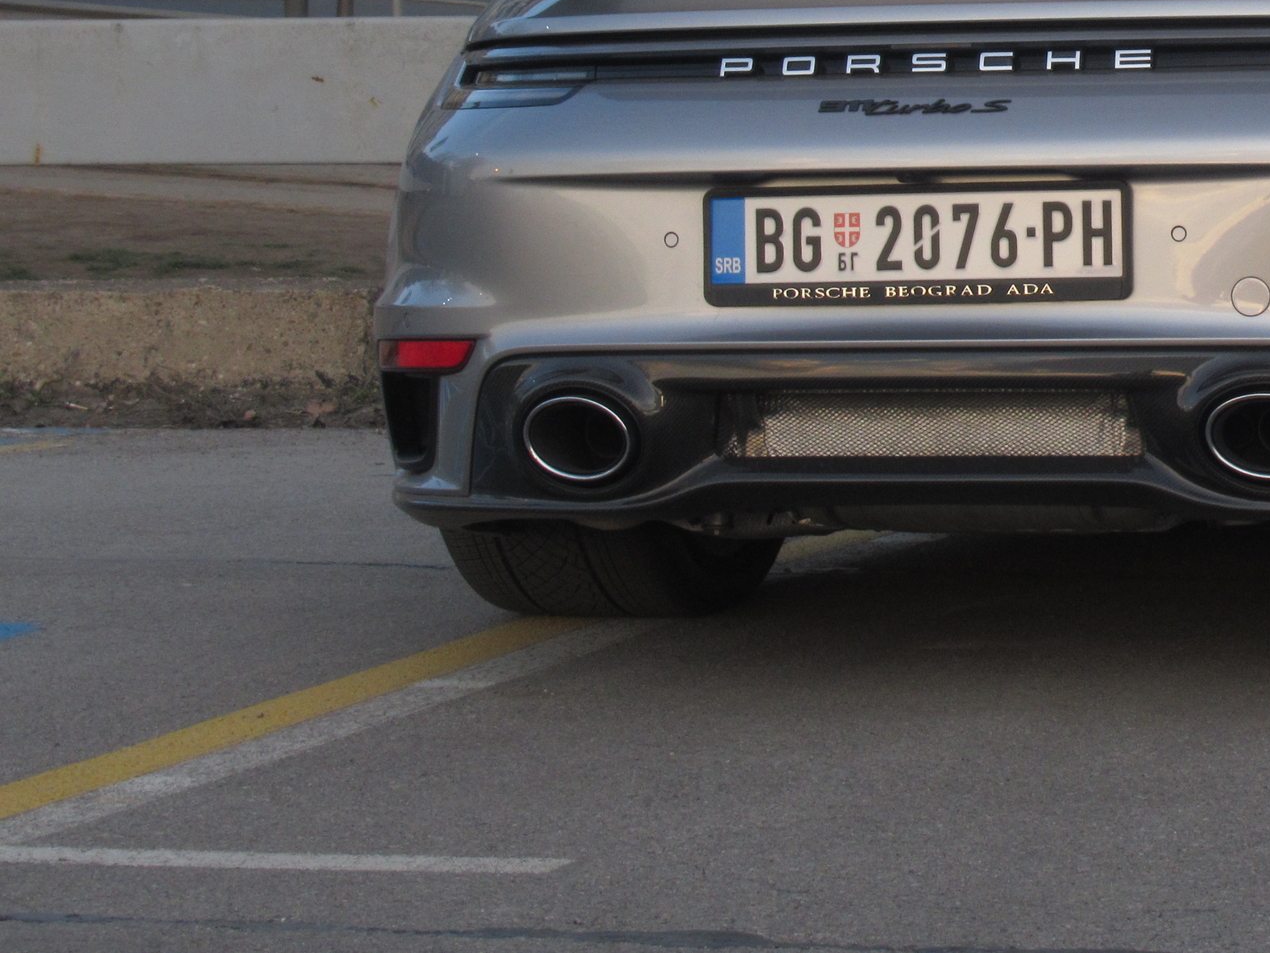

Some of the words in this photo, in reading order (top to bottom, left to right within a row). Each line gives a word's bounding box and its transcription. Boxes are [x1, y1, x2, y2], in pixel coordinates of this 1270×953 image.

[719, 49, 1152, 77] PORSCHE
[755, 207, 822, 274] BG
[715, 257, 742, 274] SRB
[772, 286, 871, 300] PORSCHE
[884, 284, 993, 298] BEOGRAD
[1006, 283, 1055, 296] ADA
